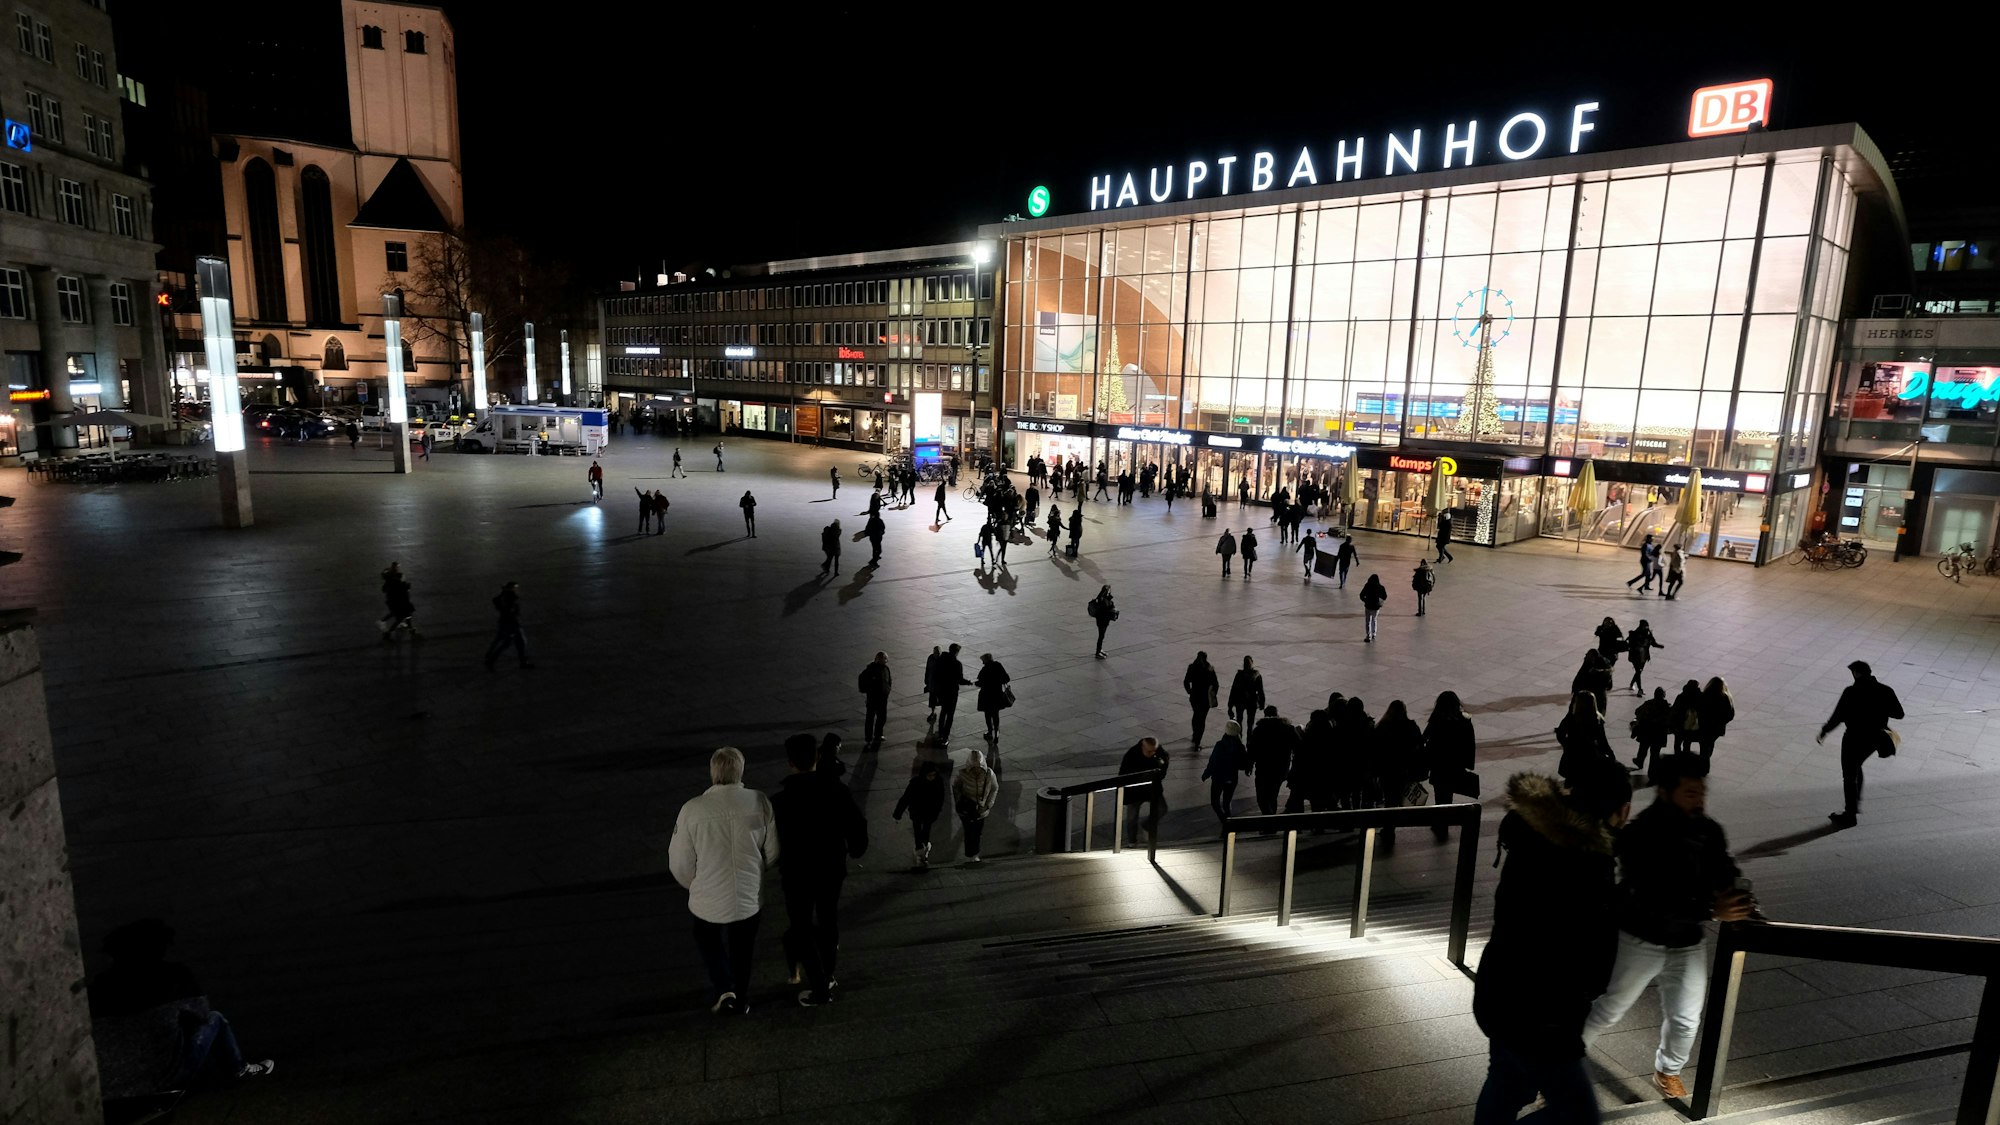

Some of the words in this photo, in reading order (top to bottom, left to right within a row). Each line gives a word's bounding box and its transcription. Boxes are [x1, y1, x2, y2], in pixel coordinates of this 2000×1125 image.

[1700, 89, 1759, 128] DB
[1090, 101, 1601, 211] HAUPTBAHNHOF
[1031, 189, 1047, 214] S
[1016, 421, 1029, 430] THE
[1046, 424, 1065, 433] SHOP
[1390, 456, 1432, 472] Kamps
